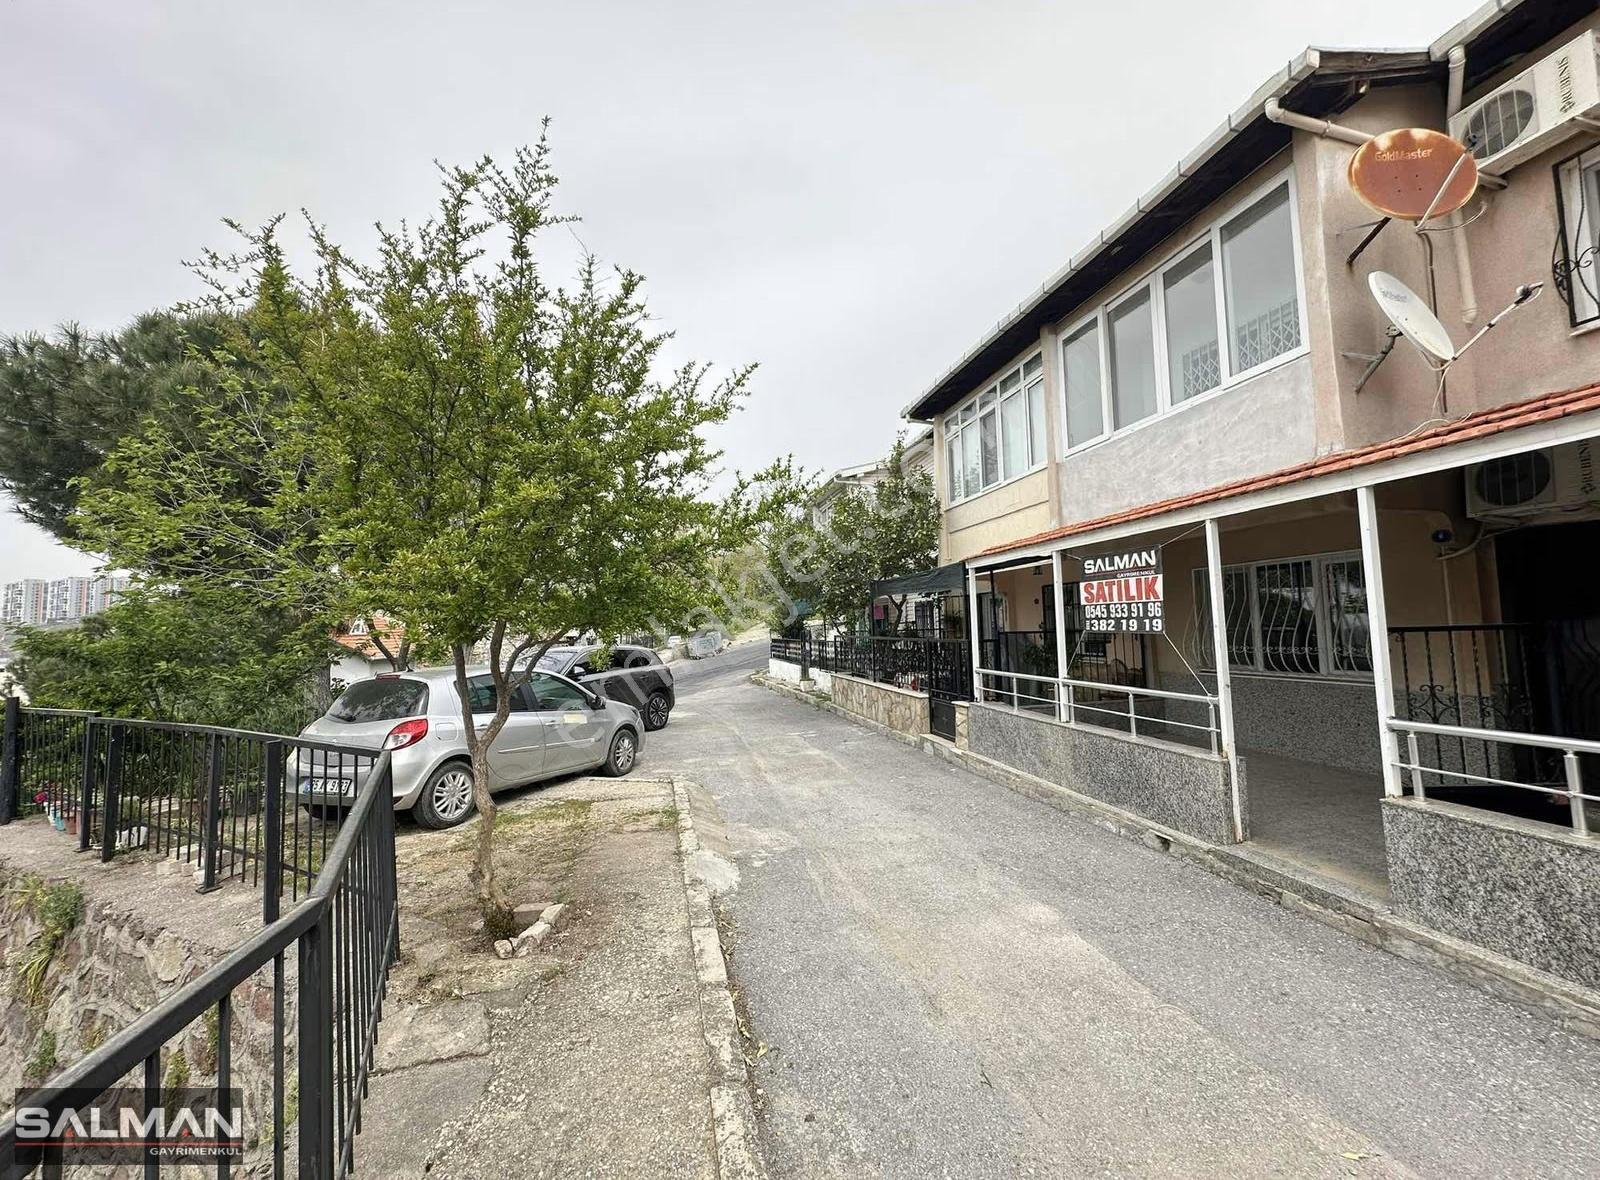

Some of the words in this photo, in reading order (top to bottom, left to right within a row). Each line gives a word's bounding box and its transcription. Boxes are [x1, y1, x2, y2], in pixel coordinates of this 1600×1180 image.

[1084, 550, 1156, 574] SALMAN
[1084, 576, 1160, 603] SATILIK
[1085, 605, 1107, 618] 0545
[1110, 604, 1128, 618] 933
[1131, 603, 1143, 617] 91
[1147, 602, 1162, 617] 96
[1091, 619, 1115, 631] 382
[1120, 619, 1138, 631] 19
[1143, 618, 1162, 631] 19
